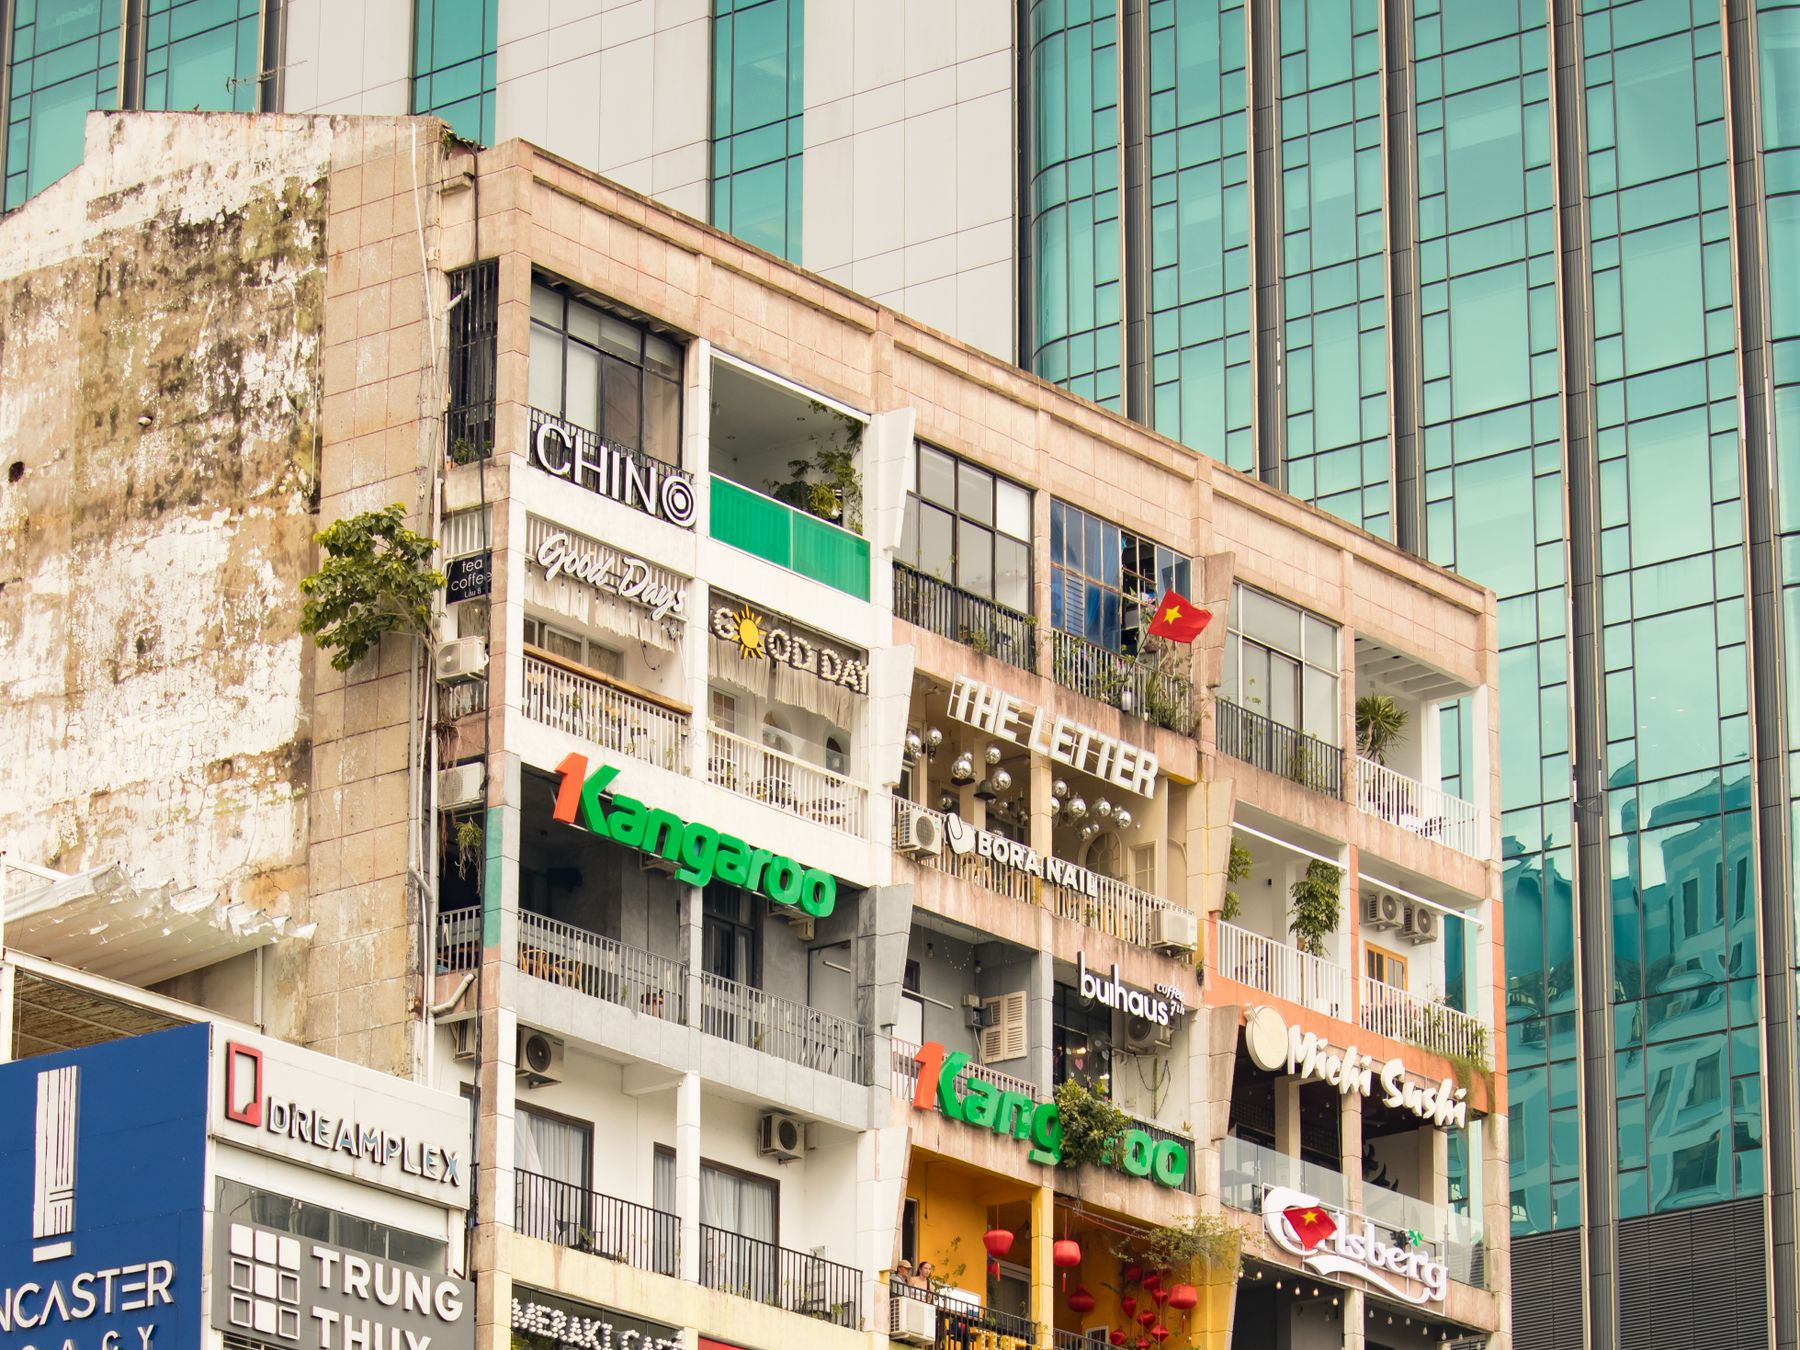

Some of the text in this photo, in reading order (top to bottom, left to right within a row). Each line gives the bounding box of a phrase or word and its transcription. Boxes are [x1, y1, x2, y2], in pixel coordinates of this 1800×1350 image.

[535, 423, 698, 529] CHINO
[451, 571, 492, 591] coffee
[462, 559, 483, 573] tea
[537, 533, 615, 587] Good
[955, 674, 1160, 800] THE LETTER
[978, 832, 1042, 878] BORA
[1155, 983, 1185, 1000] coffee
[1170, 1001, 1185, 1017] 7th
[1381, 1058, 1467, 1129] Sushi
[267, 1096, 463, 1188] DREAMPLEX
[1264, 1186, 1449, 1304] Clsberg
[313, 1245, 464, 1323] TRUNG
